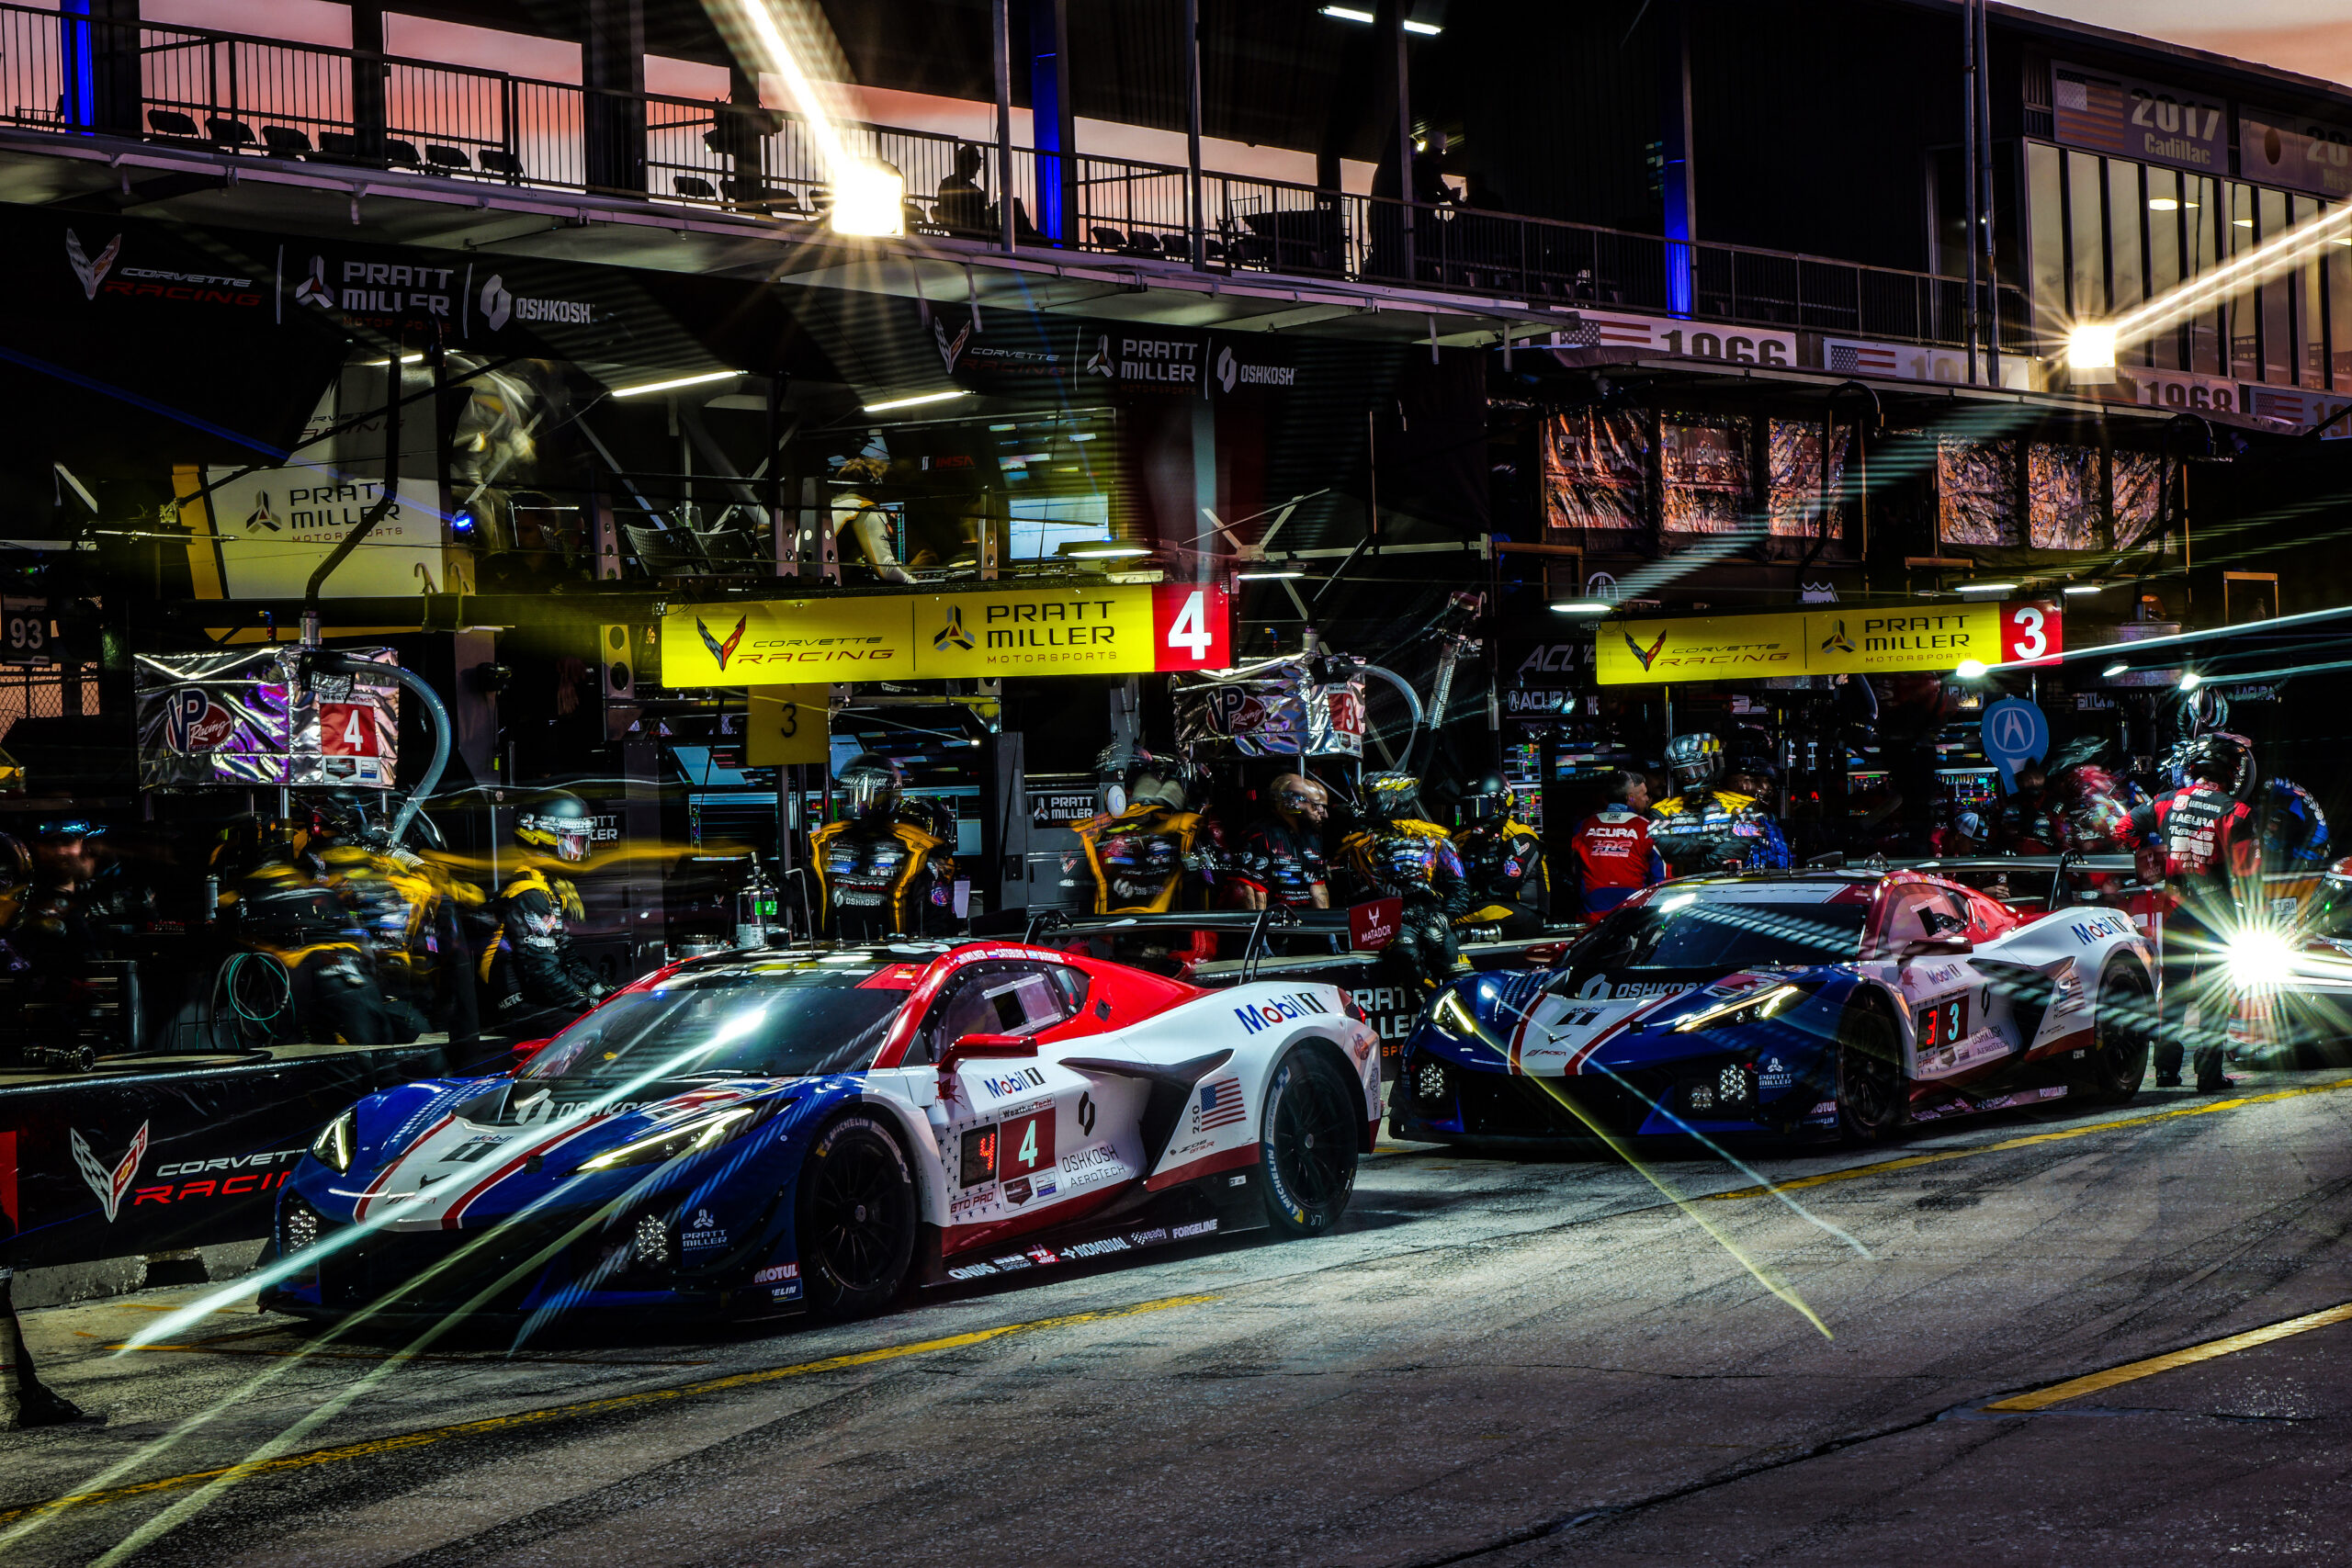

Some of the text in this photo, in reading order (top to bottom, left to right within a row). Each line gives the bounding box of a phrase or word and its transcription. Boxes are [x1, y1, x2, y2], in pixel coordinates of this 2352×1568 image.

[2130, 88, 2221, 141] 2017
[2144, 132, 2211, 165] Cadillac
[2306, 127, 2352, 167] 20
[119, 266, 253, 288] CORVETTE
[344, 260, 455, 290] PRATT
[104, 279, 264, 308] RACING
[515, 297, 591, 323] OSHKOSH
[343, 316, 453, 333] MOTORPOS
[970, 347, 1060, 361] CORVETTE
[1122, 337, 1199, 360] PRATT
[1121, 359, 1196, 382] MILLER
[1240, 364, 1295, 386] OSHKOSH
[291, 526, 403, 544] MOTORORTS
[986, 600, 1115, 626] PRATT
[1864, 615, 1971, 633] PRATT
[9, 617, 43, 649] 93
[987, 625, 1115, 648] MILLER
[1168, 590, 1212, 661] 4
[2013, 606, 2048, 660] 3
[752, 636, 883, 649] CORVETTE
[1670, 643, 1781, 656] CORVETTE
[1864, 633, 1971, 651] MILLER
[737, 649, 894, 665] RACING
[987, 650, 1117, 665] MOTORSPORTS
[1658, 652, 1790, 667] RACING
[1864, 651, 1973, 663] MOTORSPORTS
[321, 692, 375, 703] WeaerTech
[166, 687, 209, 754] VP
[780, 703, 797, 738] 3
[1206, 684, 1246, 735] VP
[1344, 699, 1354, 731] 3
[189, 717, 232, 742] Racing
[343, 709, 364, 752] 4
[1050, 795, 1094, 807] PRATT
[1050, 807, 1094, 819] MILLER
[1586, 827, 1638, 840] ACURA
[845, 897, 881, 908] OSHKOSH
[1362, 924, 1392, 942] MATADOR
[2071, 917, 2115, 946] Mobil
[1234, 992, 1329, 1035] Mobil 1
[1948, 1002, 1960, 1041] 3
[1926, 1010, 1938, 1045] 3
[1971, 1024, 2004, 1044] OSHKOSH
[984, 1066, 1046, 1099] Mobil 1
[1002, 1098, 1053, 1119] WeatherTech
[1192, 1105, 1200, 1134] 250
[469, 1134, 514, 1143] Mobil
[830, 1118, 869, 1141] MICHELIN
[979, 1133, 996, 1171] 4
[1018, 1120, 1038, 1168] 4
[157, 1148, 308, 1178] CORVET
[1062, 1144, 1120, 1174] OSHKOSH
[1070, 1164, 1126, 1188] AEROTECH
[1268, 1148, 1293, 1209] MICHELIN
[133, 1170, 292, 1206] RACI
[951, 1199, 971, 1213] GTD
[973, 1192, 993, 1207] PRO
[682, 1229, 728, 1241] PRATT
[683, 1235, 728, 1248] MILLER
[1073, 1235, 1132, 1258] NOMINAL
[1142, 1227, 1167, 1244] ready
[1172, 1218, 1218, 1240] FORGELINE
[753, 1264, 798, 1283] MOTUL
